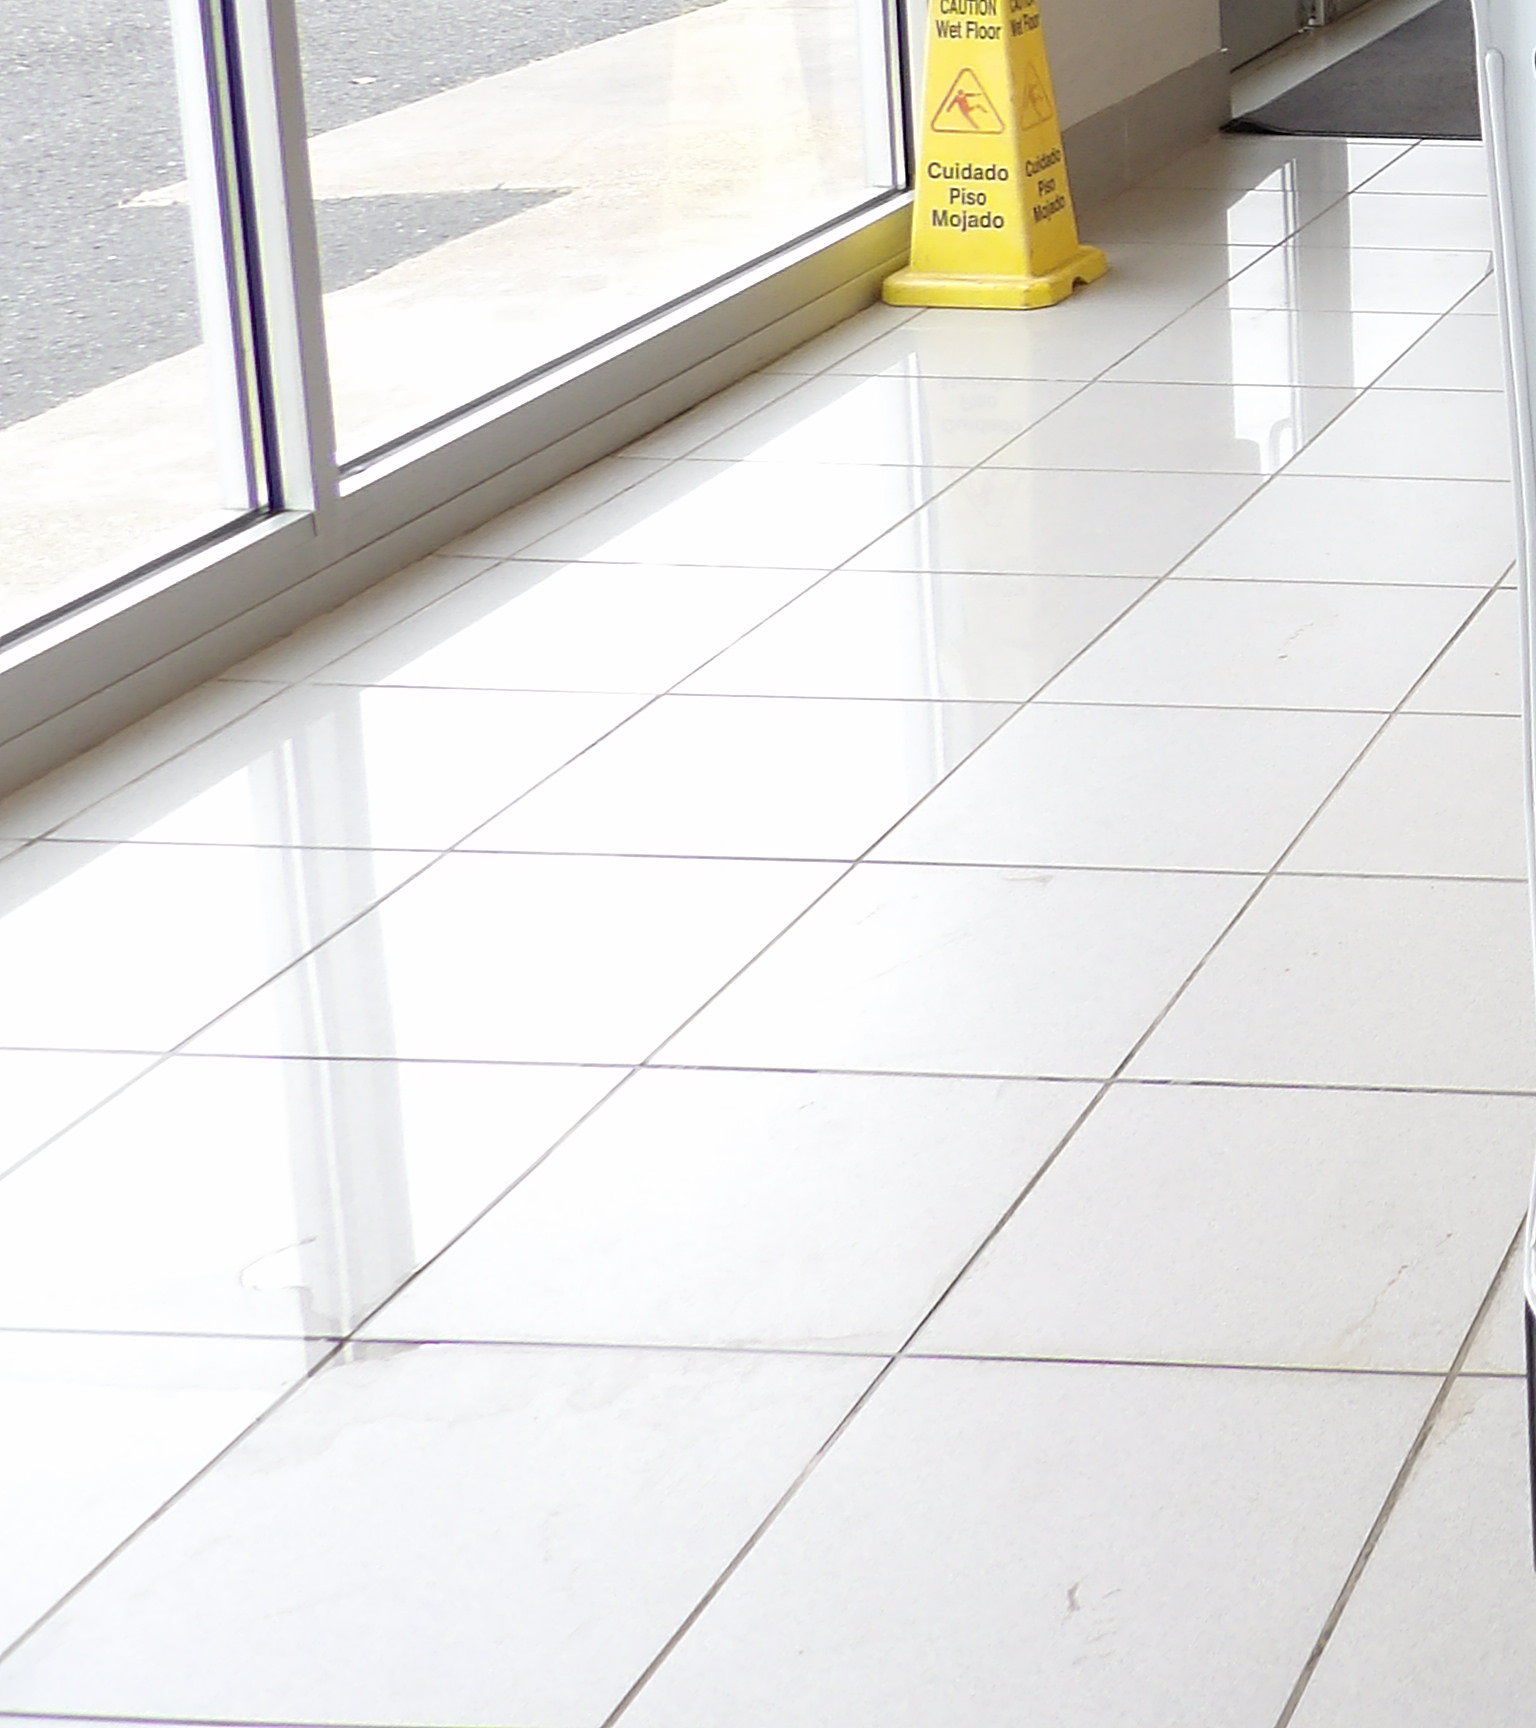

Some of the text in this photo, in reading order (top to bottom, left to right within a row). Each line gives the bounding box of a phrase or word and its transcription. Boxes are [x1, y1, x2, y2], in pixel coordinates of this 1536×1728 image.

[936, 19, 1003, 40] Wet Floor
[927, 161, 1010, 181] Cuidado
[948, 187, 988, 206] Piso
[931, 209, 1005, 232] Mojado
